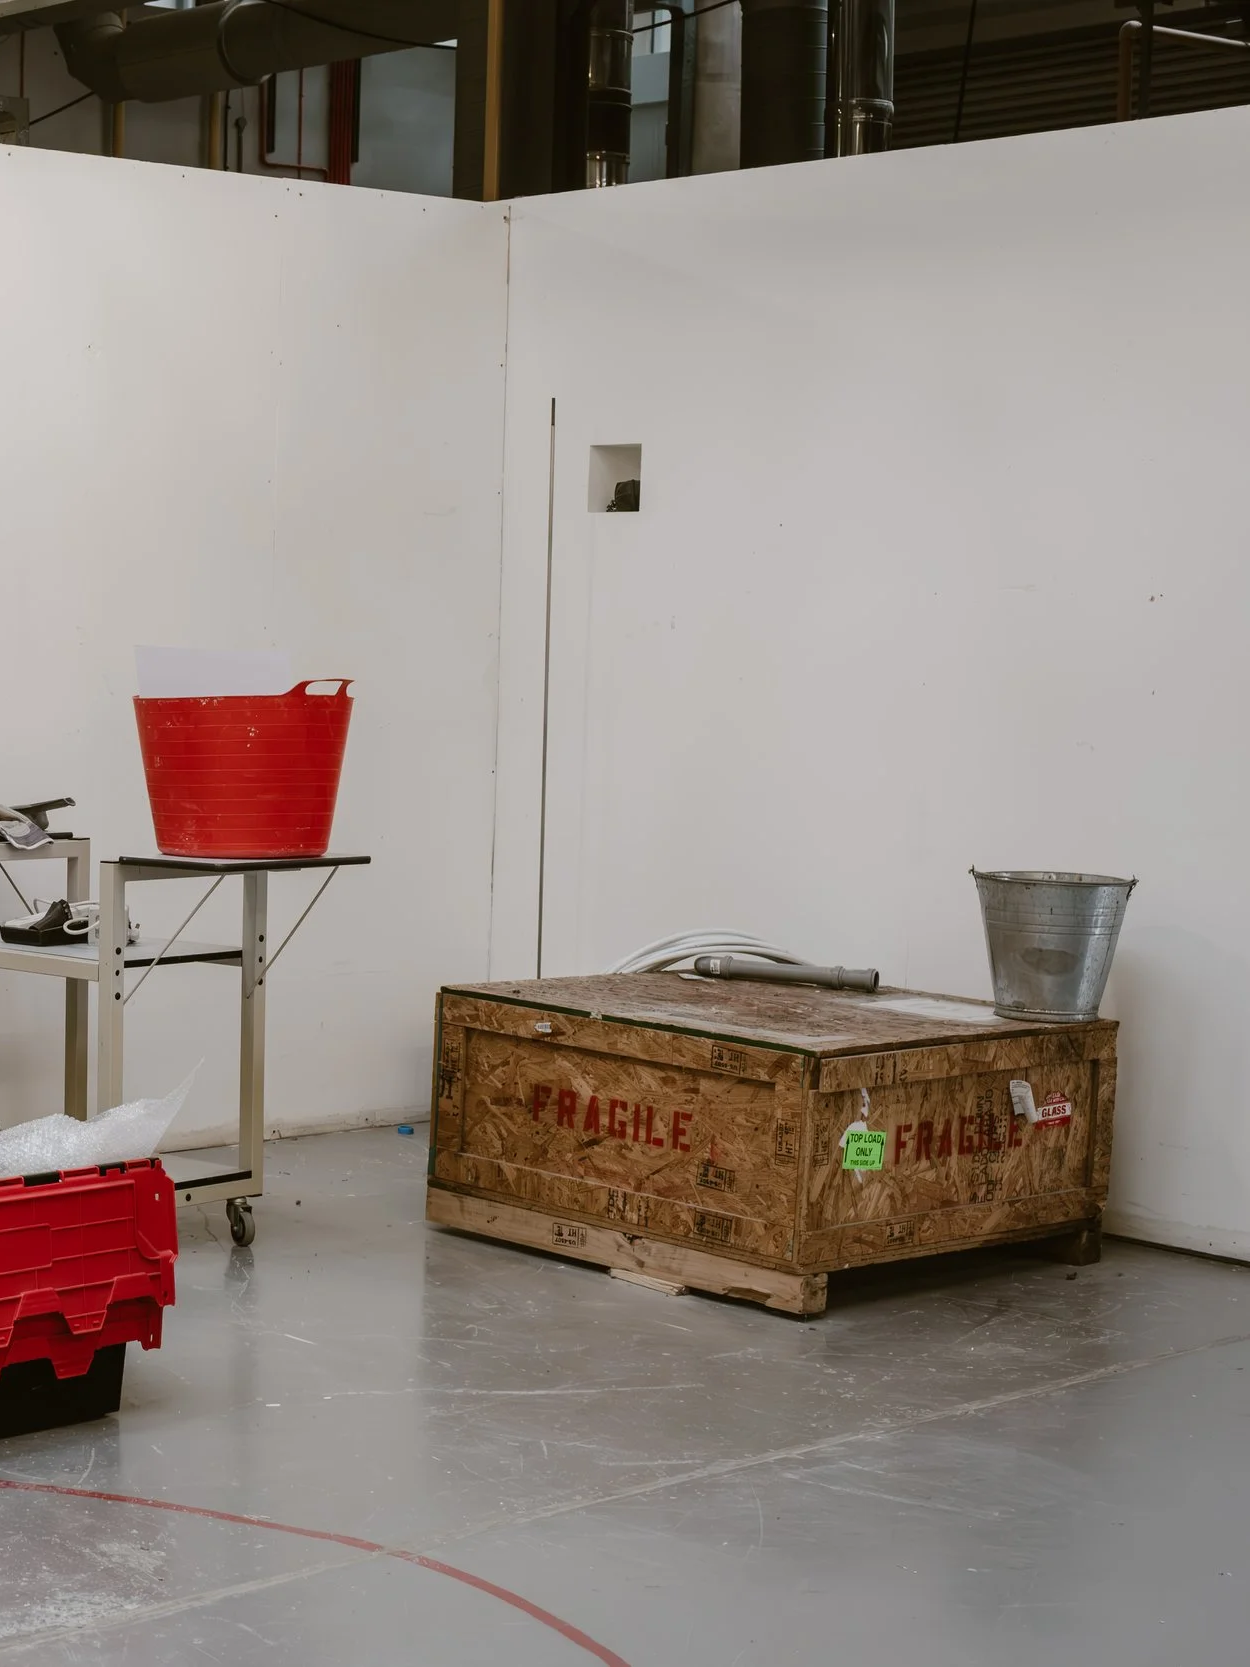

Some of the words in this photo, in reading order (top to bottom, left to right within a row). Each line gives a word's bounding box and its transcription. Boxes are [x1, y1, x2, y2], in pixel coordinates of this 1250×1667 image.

[532, 1083, 693, 1152] FRAGILE
[1041, 1105, 1067, 1118] GLASS
[850, 1133, 864, 1143] TOP
[864, 1134, 882, 1144] LOAD
[894, 1112, 1022, 1168] FRAGILE
[855, 1147, 873, 1157] ONLY
